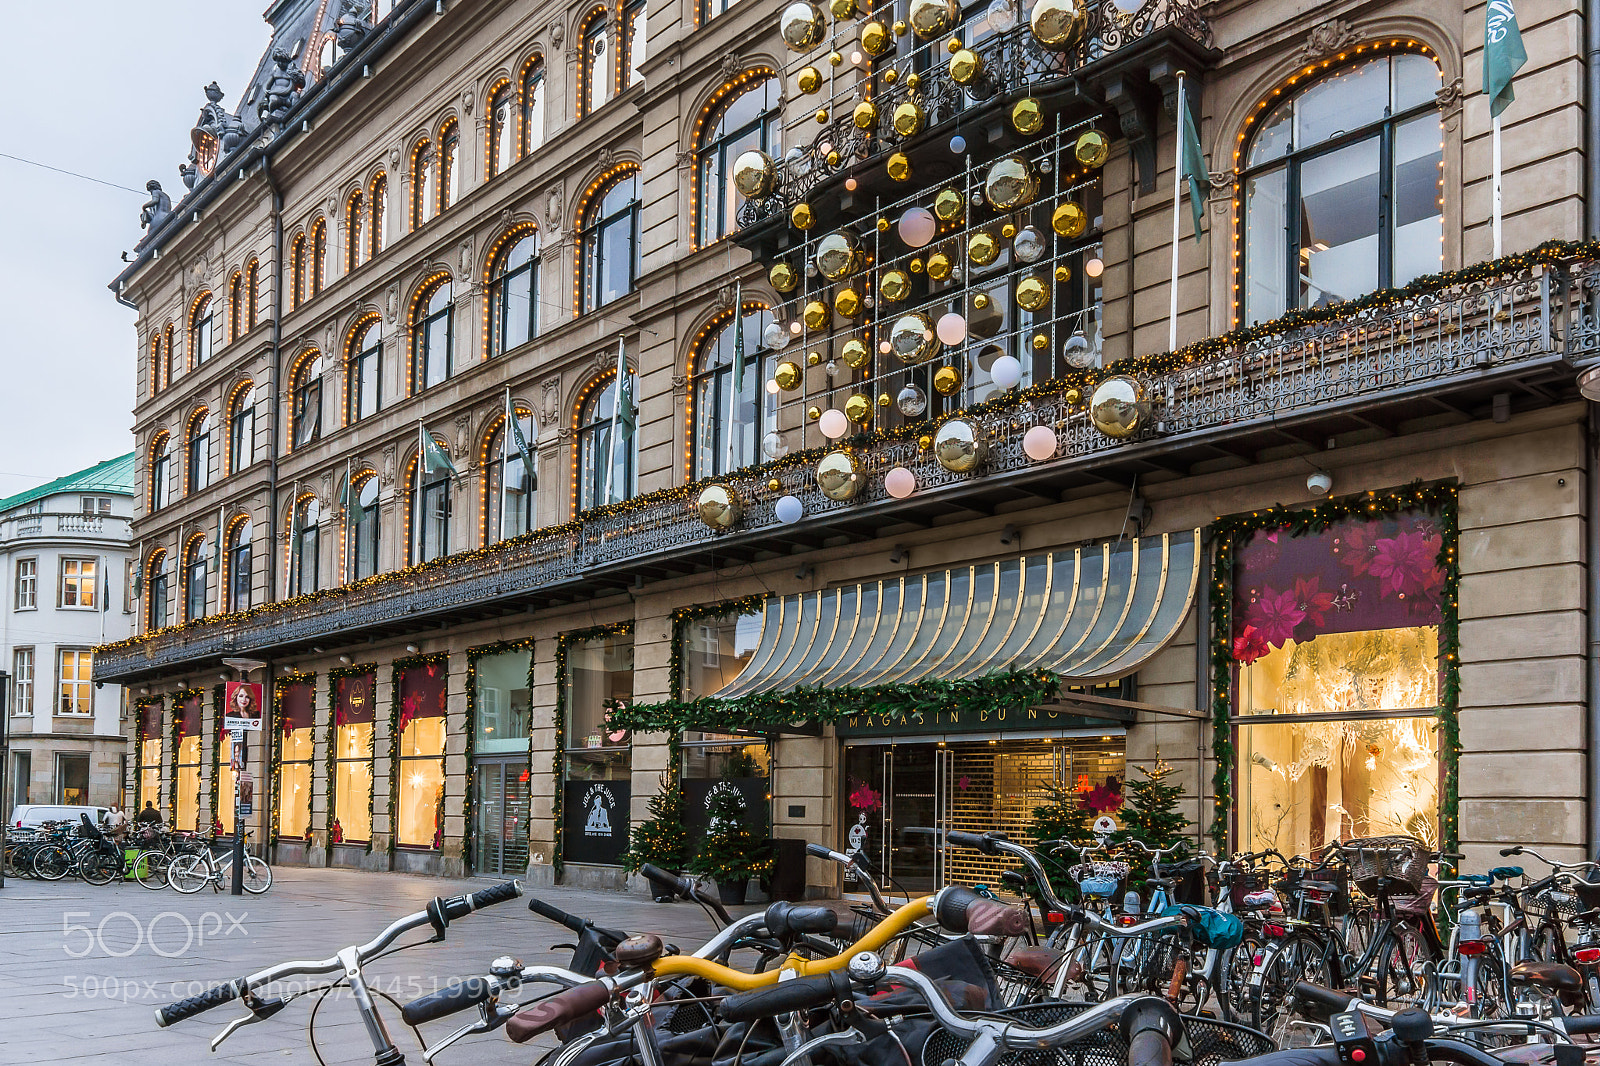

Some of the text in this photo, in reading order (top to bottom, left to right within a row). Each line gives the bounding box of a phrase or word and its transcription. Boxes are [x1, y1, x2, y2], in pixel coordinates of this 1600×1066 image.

[849, 711, 959, 728] MAGASIN
[980, 708, 1006, 722] DU
[582, 791, 591, 808] JOE
[594, 783, 605, 793] THE
[603, 787, 616, 809] JUICE
[712, 785, 719, 795] &
